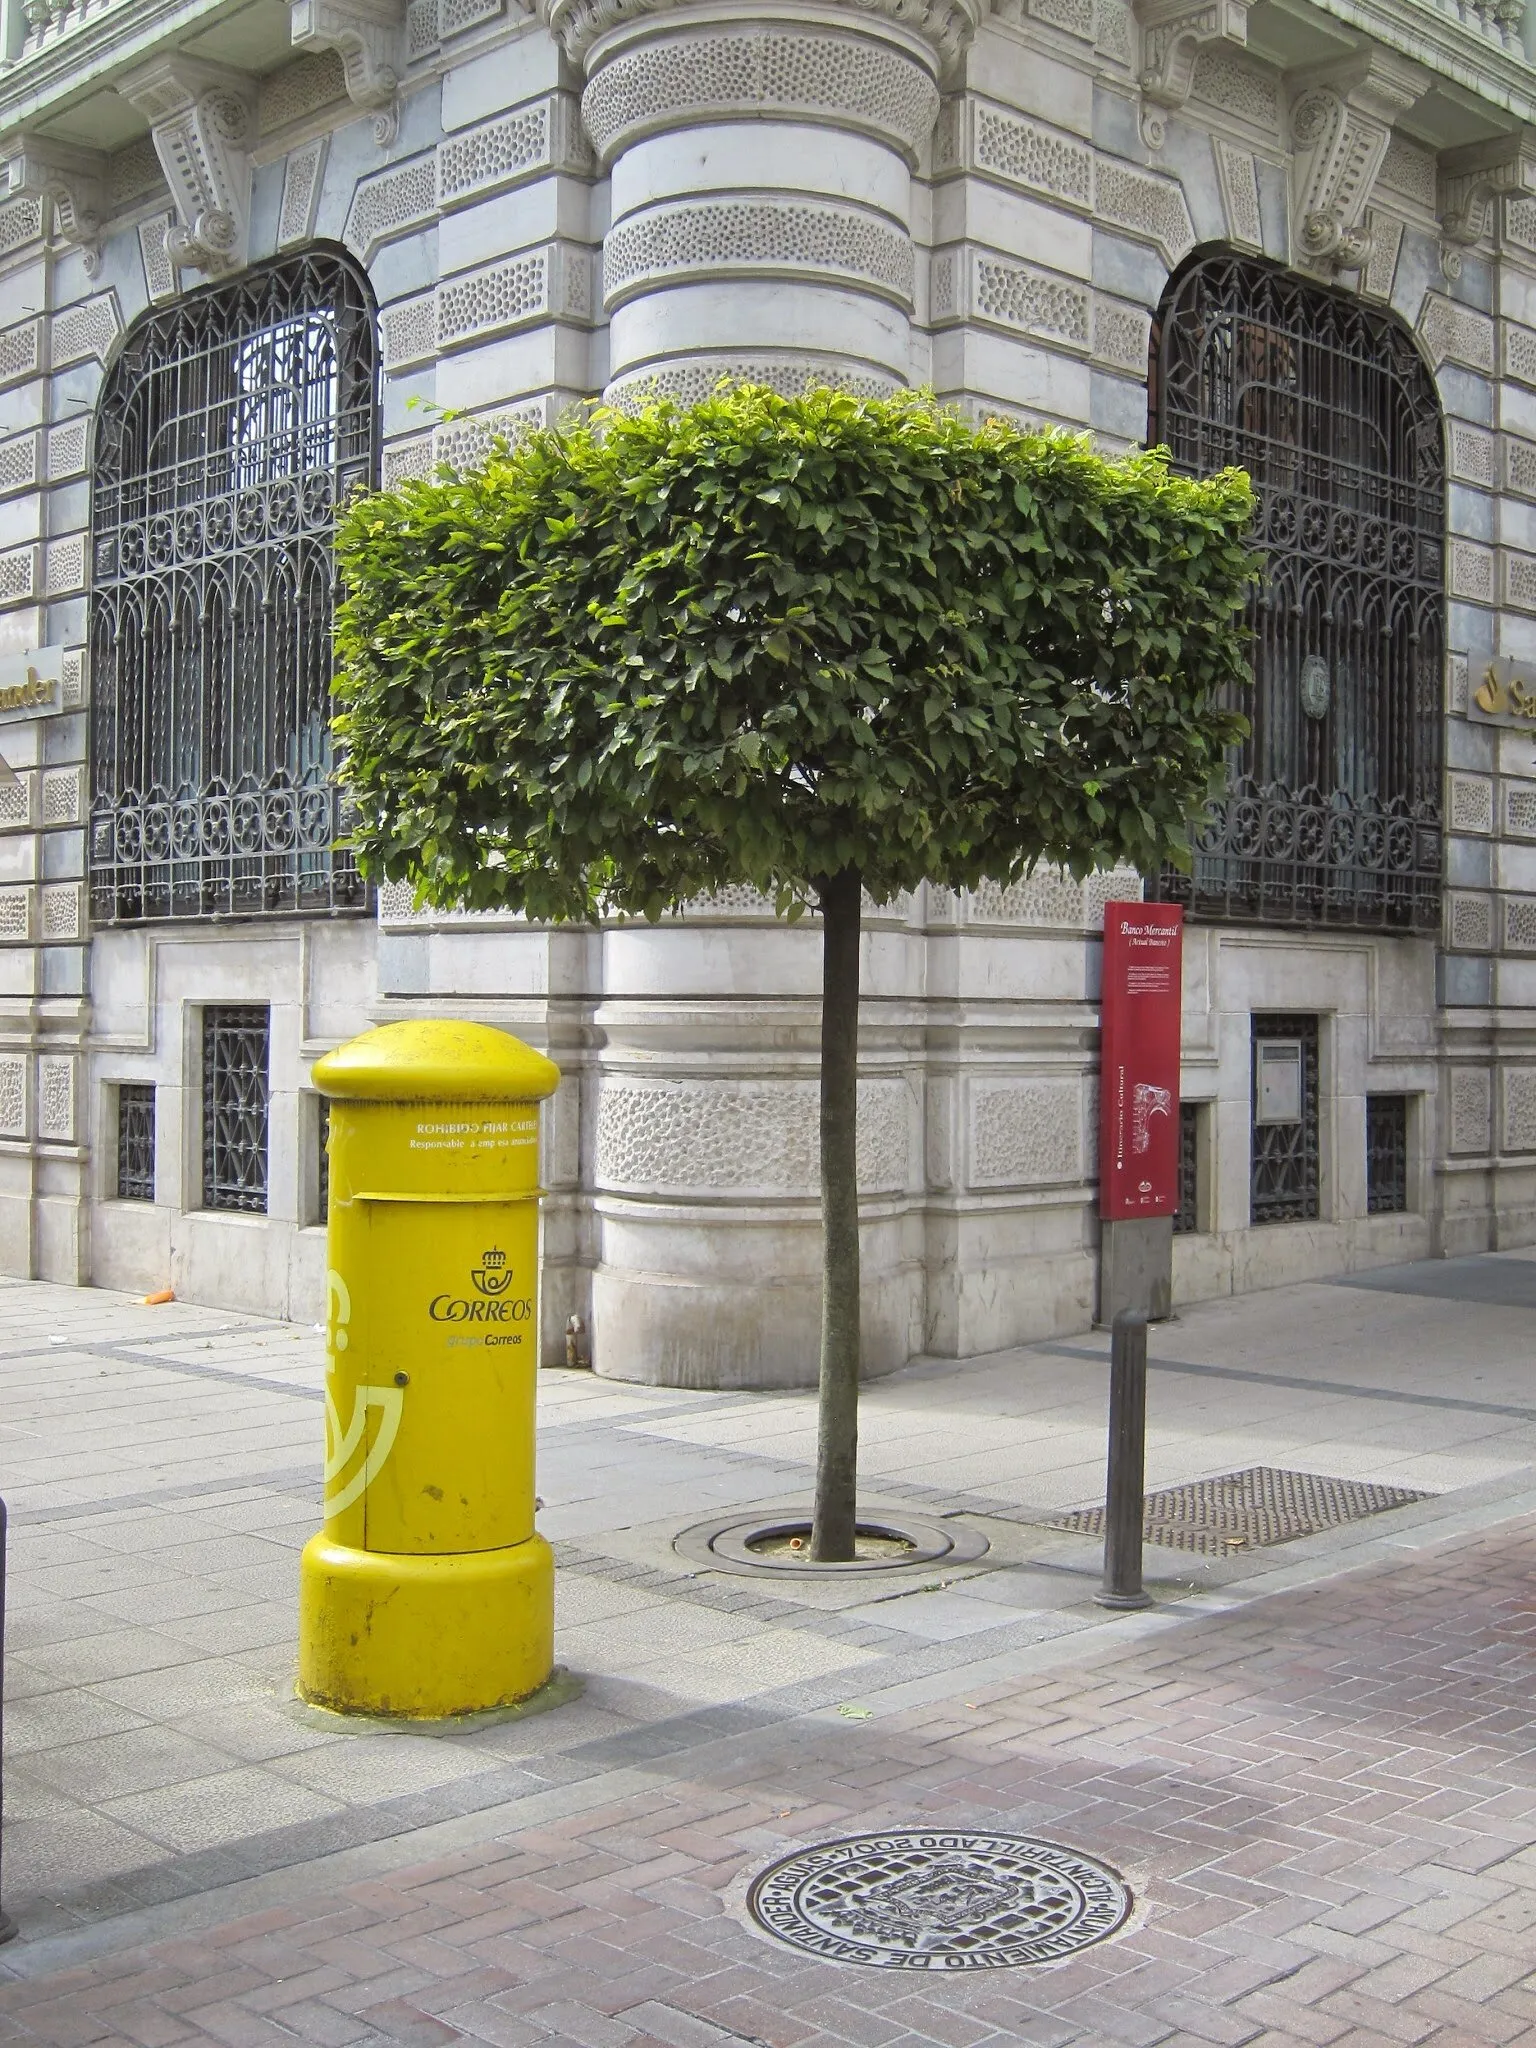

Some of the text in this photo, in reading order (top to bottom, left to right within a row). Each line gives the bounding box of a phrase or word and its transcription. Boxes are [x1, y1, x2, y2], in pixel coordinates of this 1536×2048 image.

[1121, 921, 1178, 936] Banco Mercantil
[483, 1122, 508, 1134] FIJAR
[429, 1294, 532, 1321] CORREOS
[484, 1334, 522, 1346] Correos
[835, 1837, 1117, 1902] ALCANTARILLADO 2004
[762, 1855, 1117, 1968] AYUNTAMIENTO DE SANTANDER AGUAS
